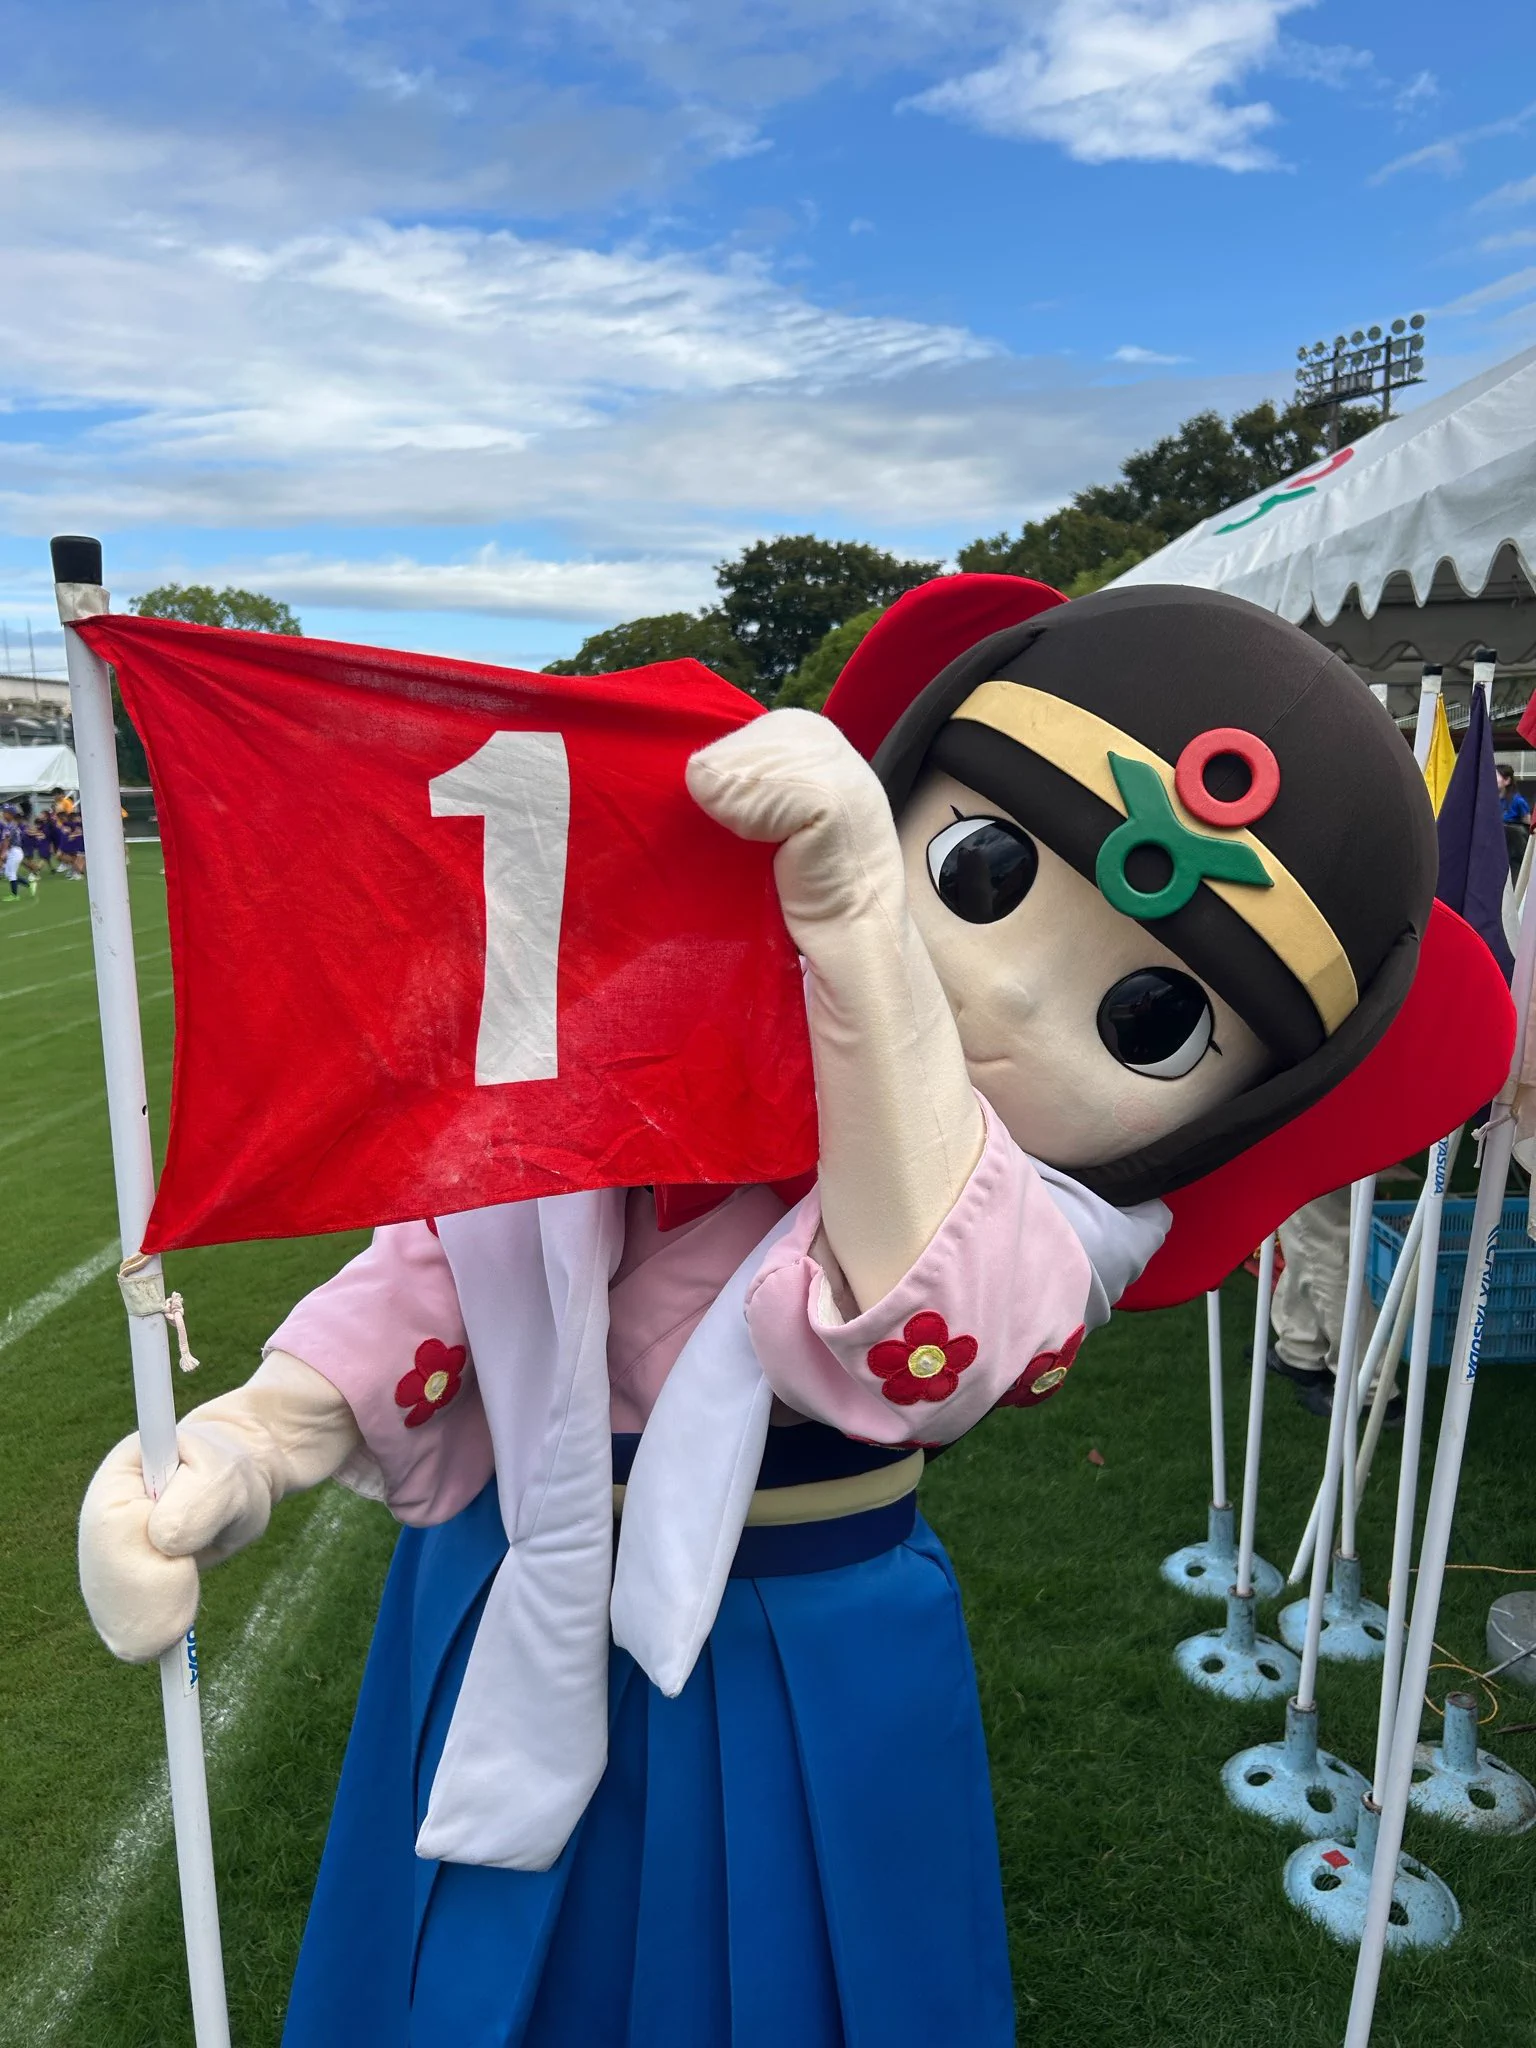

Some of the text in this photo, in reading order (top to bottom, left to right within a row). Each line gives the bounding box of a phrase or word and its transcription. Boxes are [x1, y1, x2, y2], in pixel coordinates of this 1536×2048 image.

[429, 731, 570, 1086] 1
[1435, 1139, 1449, 1194] YASUDA
[1466, 1304, 1487, 1378] YASUDA
